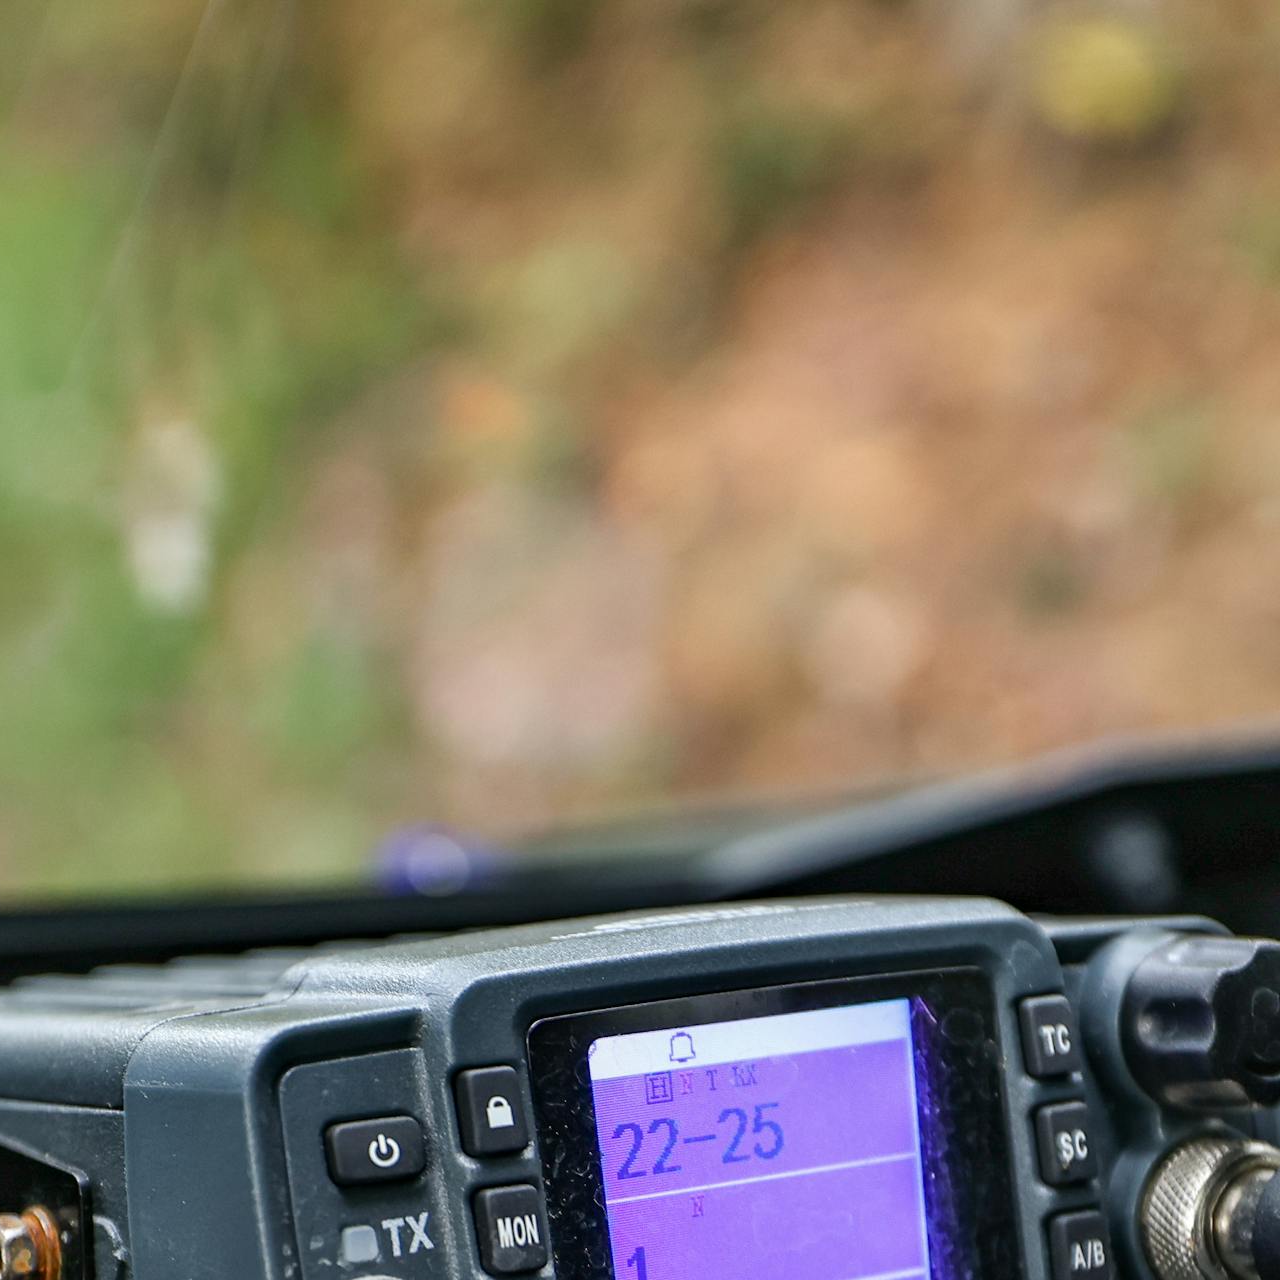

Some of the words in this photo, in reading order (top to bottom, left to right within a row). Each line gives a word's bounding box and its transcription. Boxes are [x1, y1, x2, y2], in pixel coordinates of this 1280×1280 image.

[1039, 1024, 1071, 1056] TC
[706, 1069, 718, 1091] T
[611, 1102, 785, 1180] 22-25
[1056, 1129, 1088, 1164] SC
[381, 1211, 435, 1257] TX
[496, 1214, 540, 1249] MON
[1072, 1239, 1106, 1270] A/B
